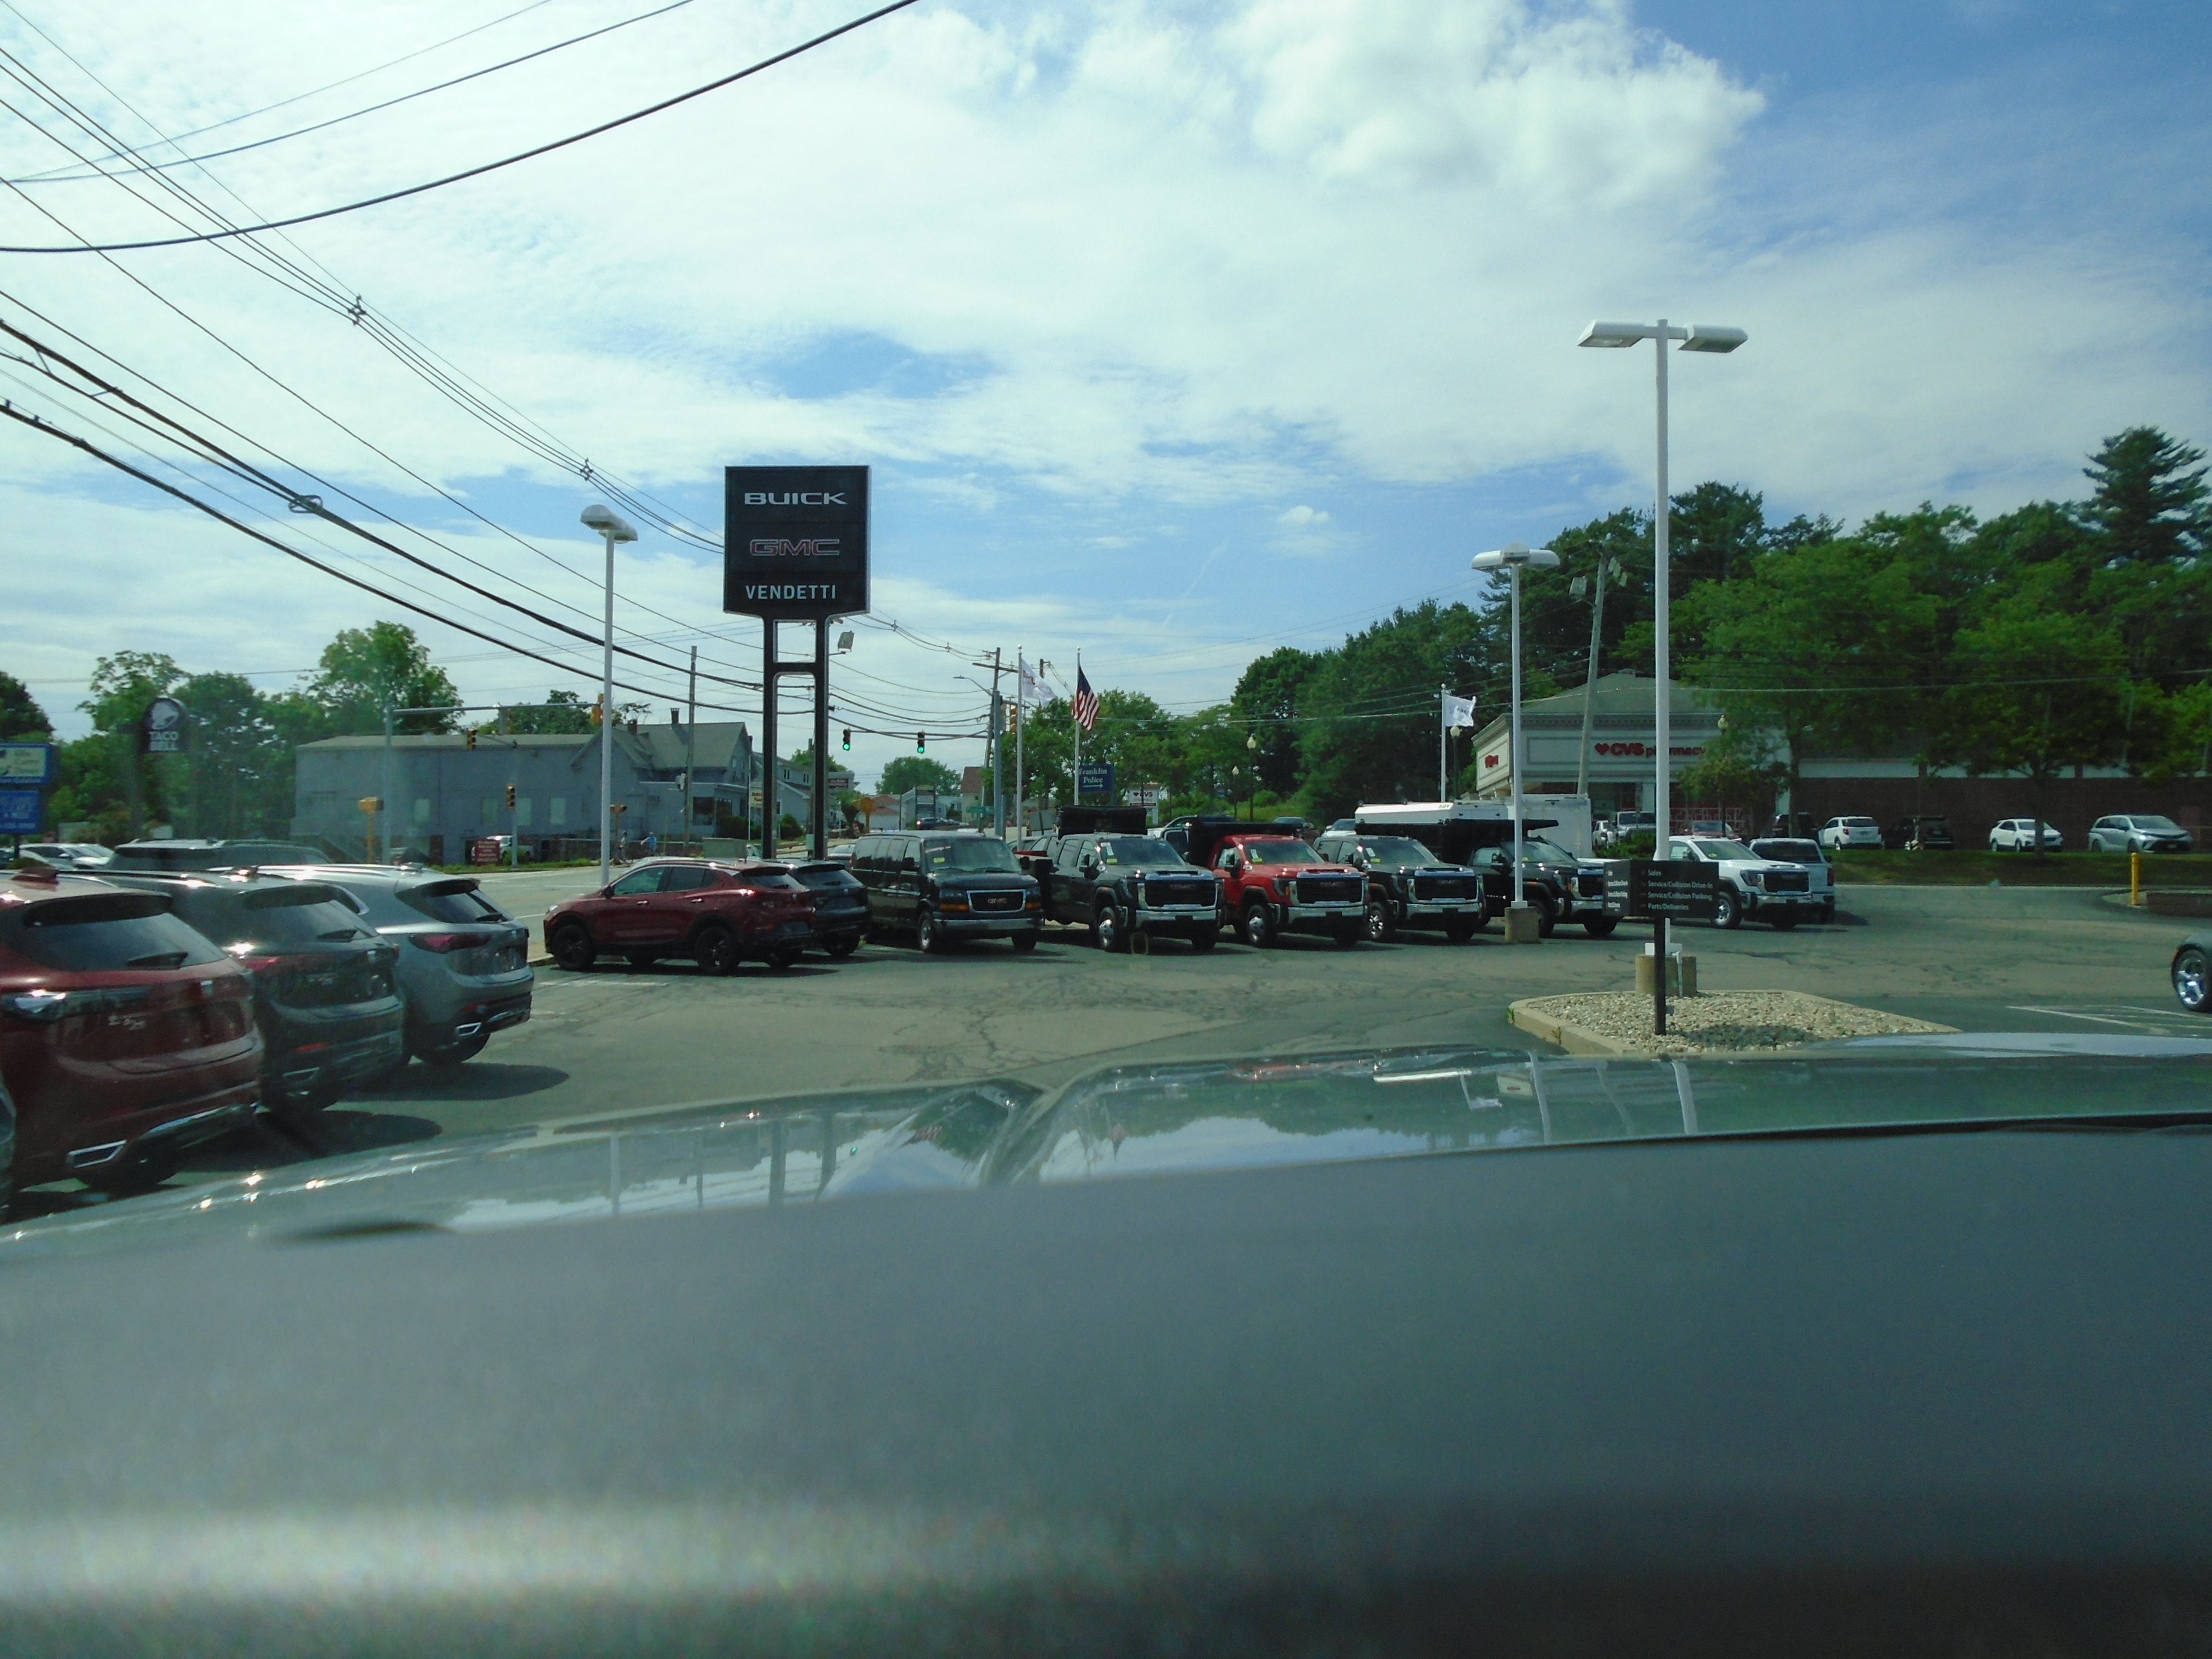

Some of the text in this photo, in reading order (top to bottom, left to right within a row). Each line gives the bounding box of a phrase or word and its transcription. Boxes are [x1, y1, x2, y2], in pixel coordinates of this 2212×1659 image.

[744, 492, 848, 505] BUICK
[750, 538, 840, 556] GMC
[746, 585, 836, 600] VENDETTI
[149, 731, 178, 741] TACO
[1610, 742, 1706, 757] CVS prmacy
